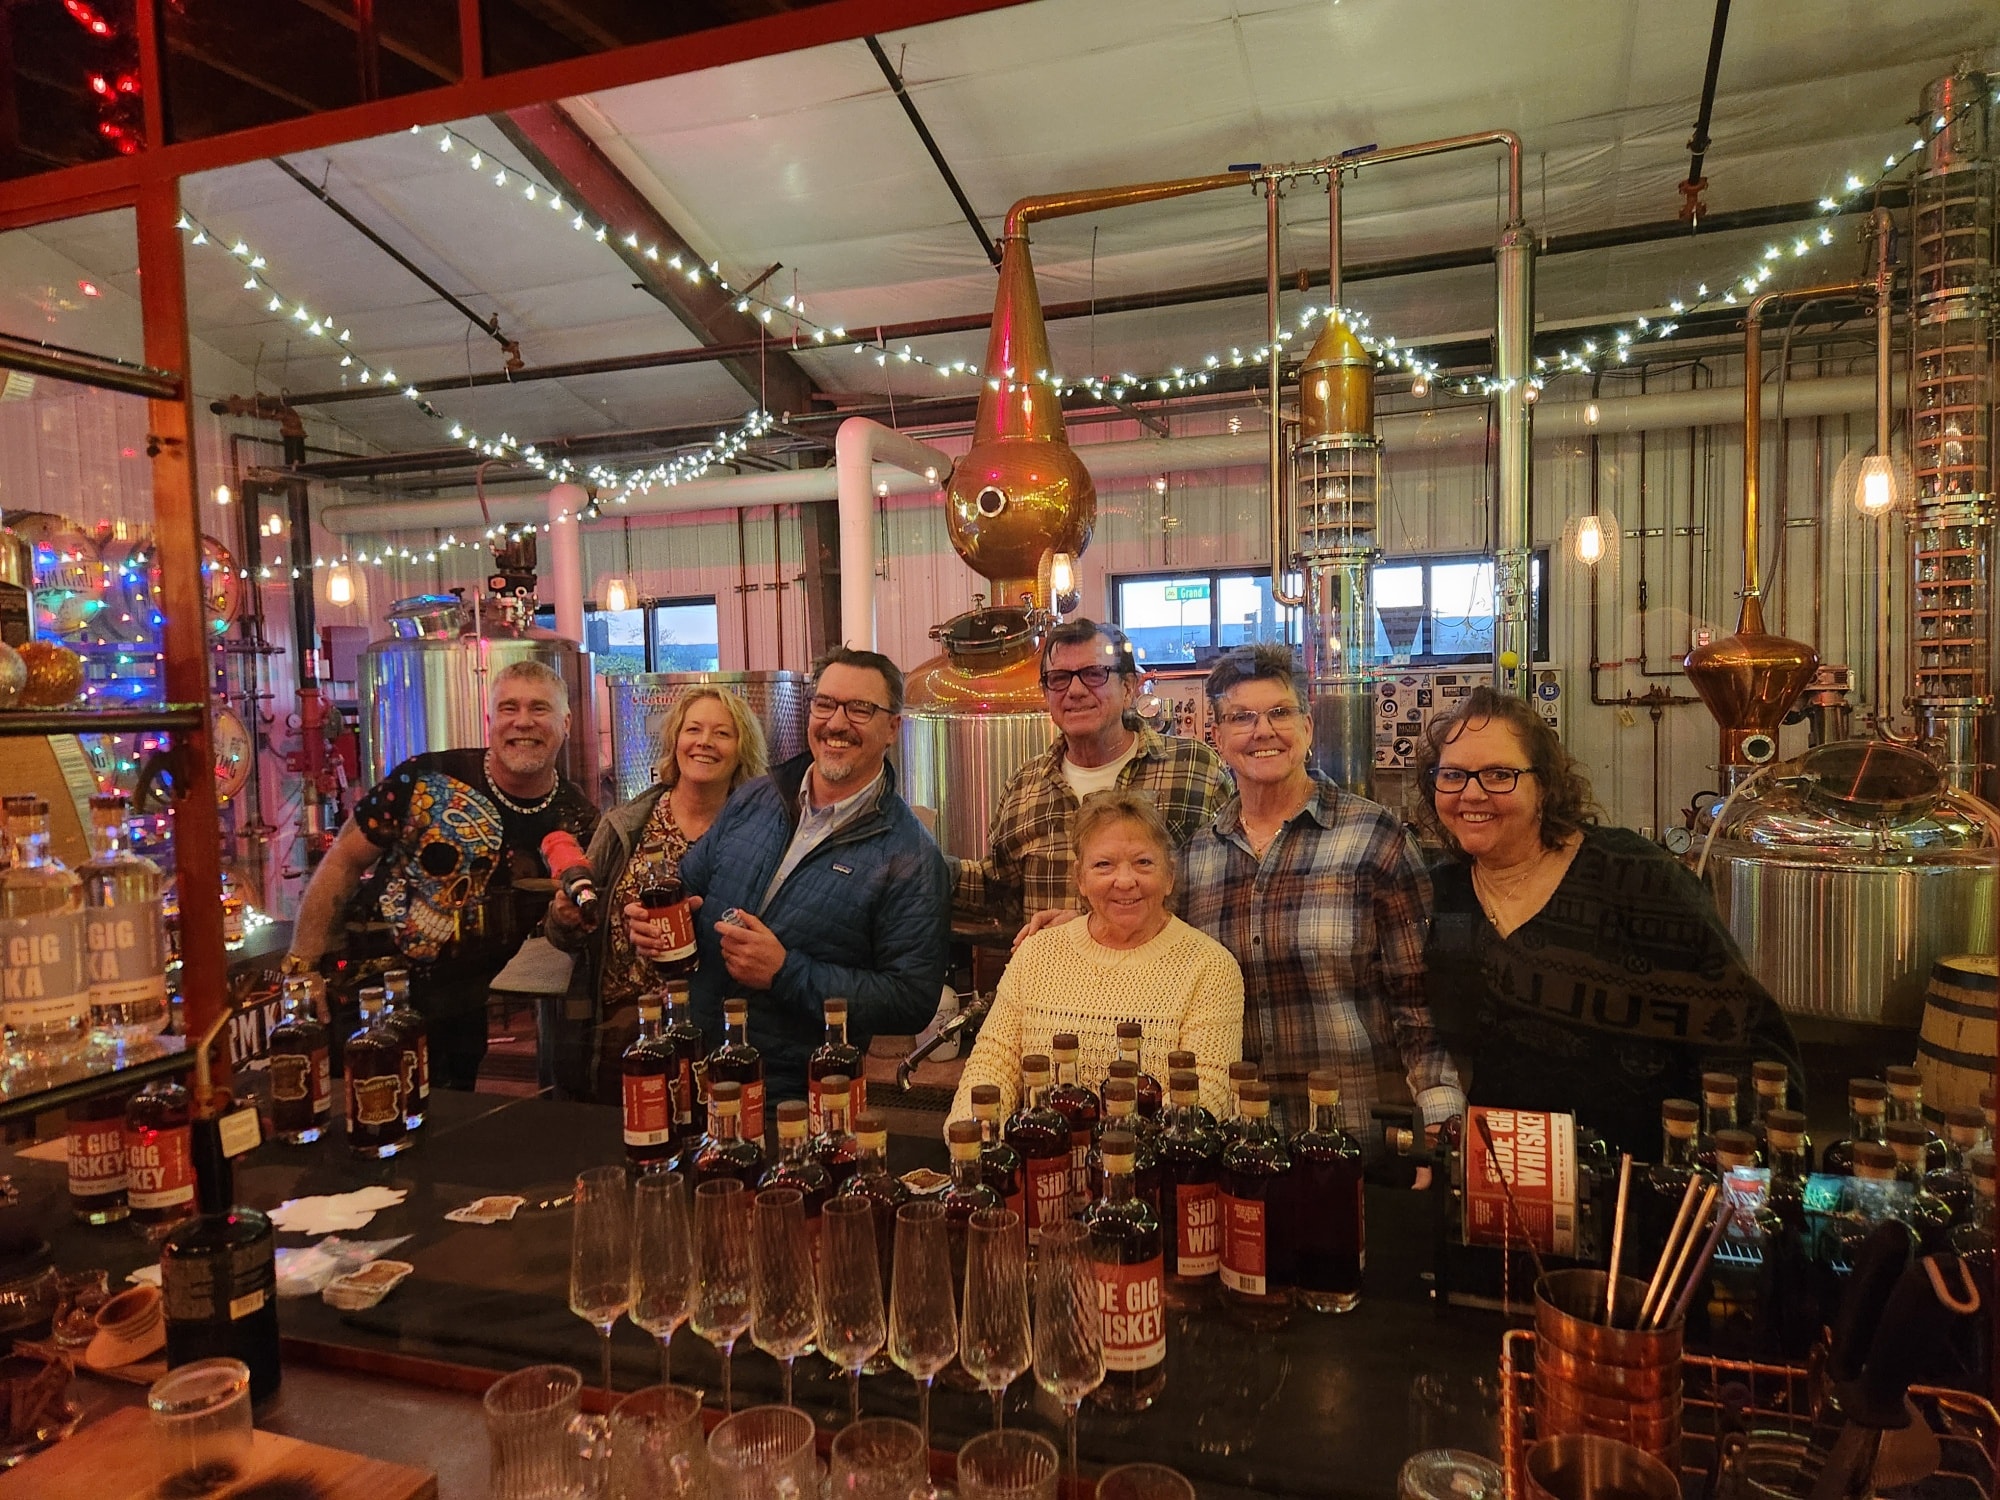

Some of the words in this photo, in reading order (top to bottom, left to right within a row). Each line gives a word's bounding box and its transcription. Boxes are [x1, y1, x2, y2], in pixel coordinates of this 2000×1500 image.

[1180, 587, 1203, 599] Grand
[1544, 686, 1555, 697] B
[88, 920, 136, 951] GIG
[9, 933, 61, 966] GIG
[87, 1131, 121, 1155] GIG
[130, 1145, 160, 1168] GIG
[1486, 1136, 1516, 1186] SIDE
[1126, 1276, 1159, 1313] GIG
